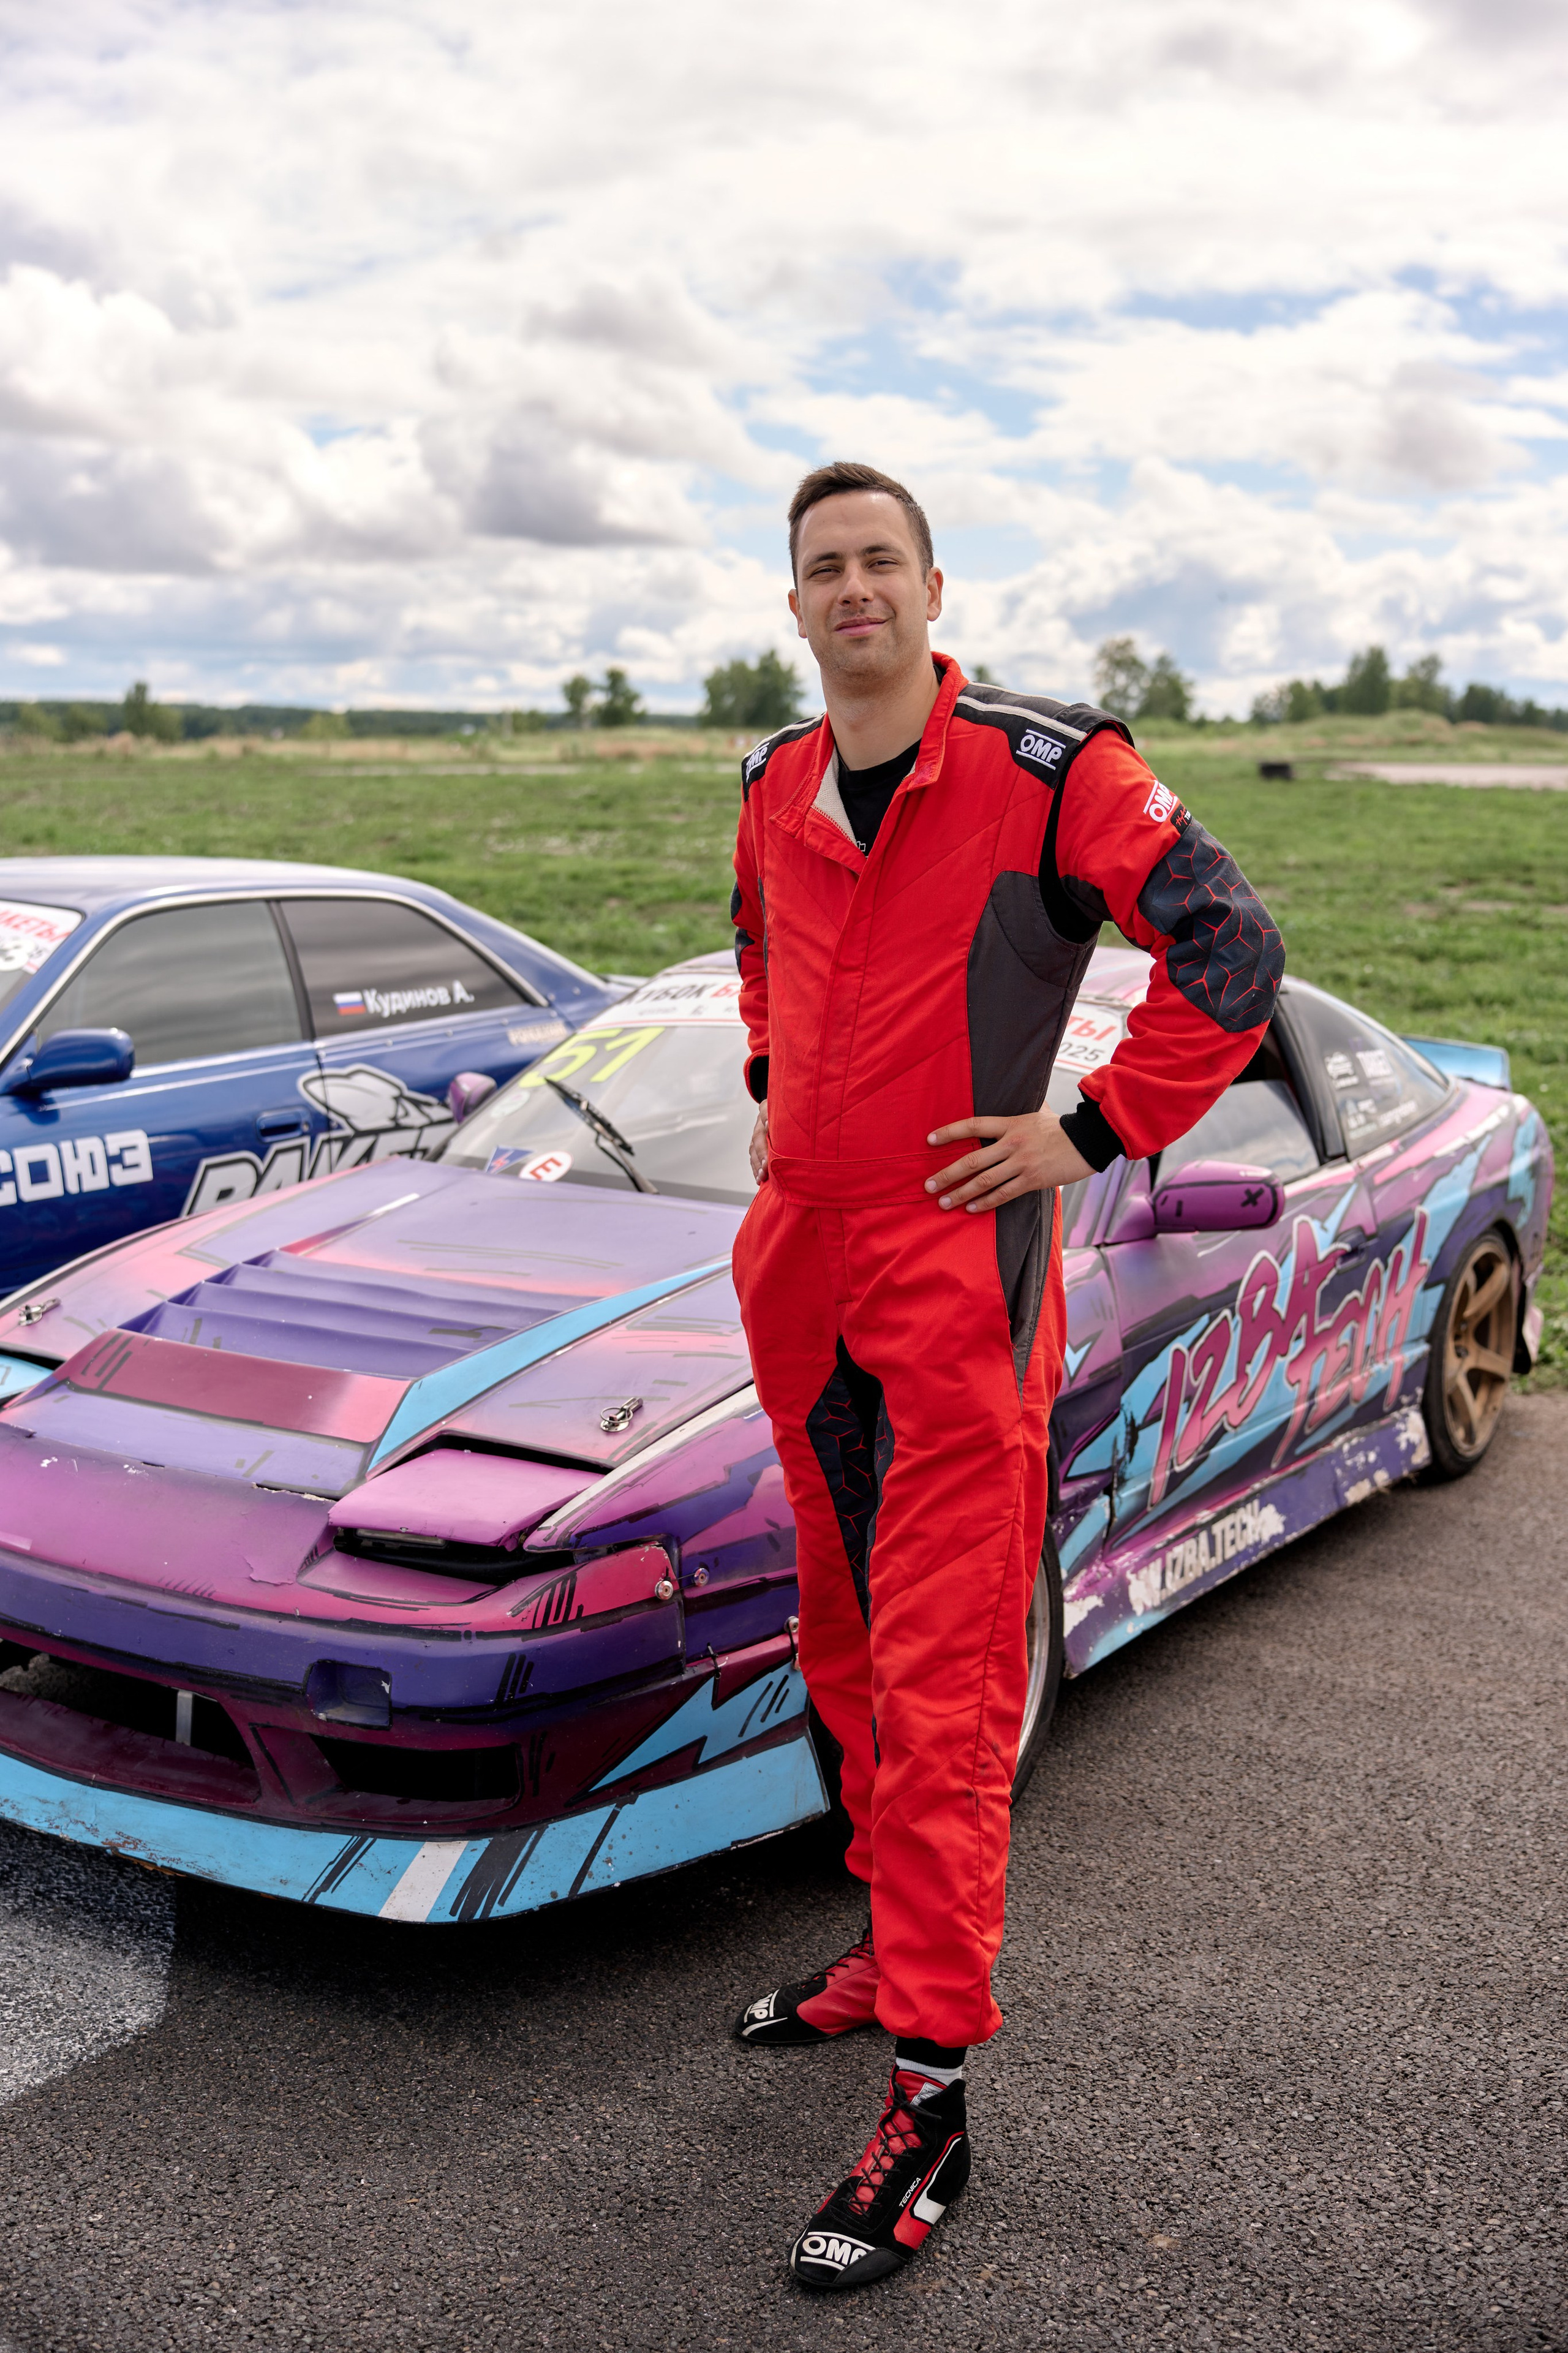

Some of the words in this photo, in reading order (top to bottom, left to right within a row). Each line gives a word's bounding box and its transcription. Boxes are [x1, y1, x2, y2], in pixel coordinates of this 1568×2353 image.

[1020, 733, 1063, 763] OMP
[1148, 782, 1174, 823] OMP
[363, 987, 452, 1018] Кудинов
[452, 979, 475, 1004] А.
[518, 1025, 666, 1088] 51
[899, 2177, 921, 2207] TECNICA
